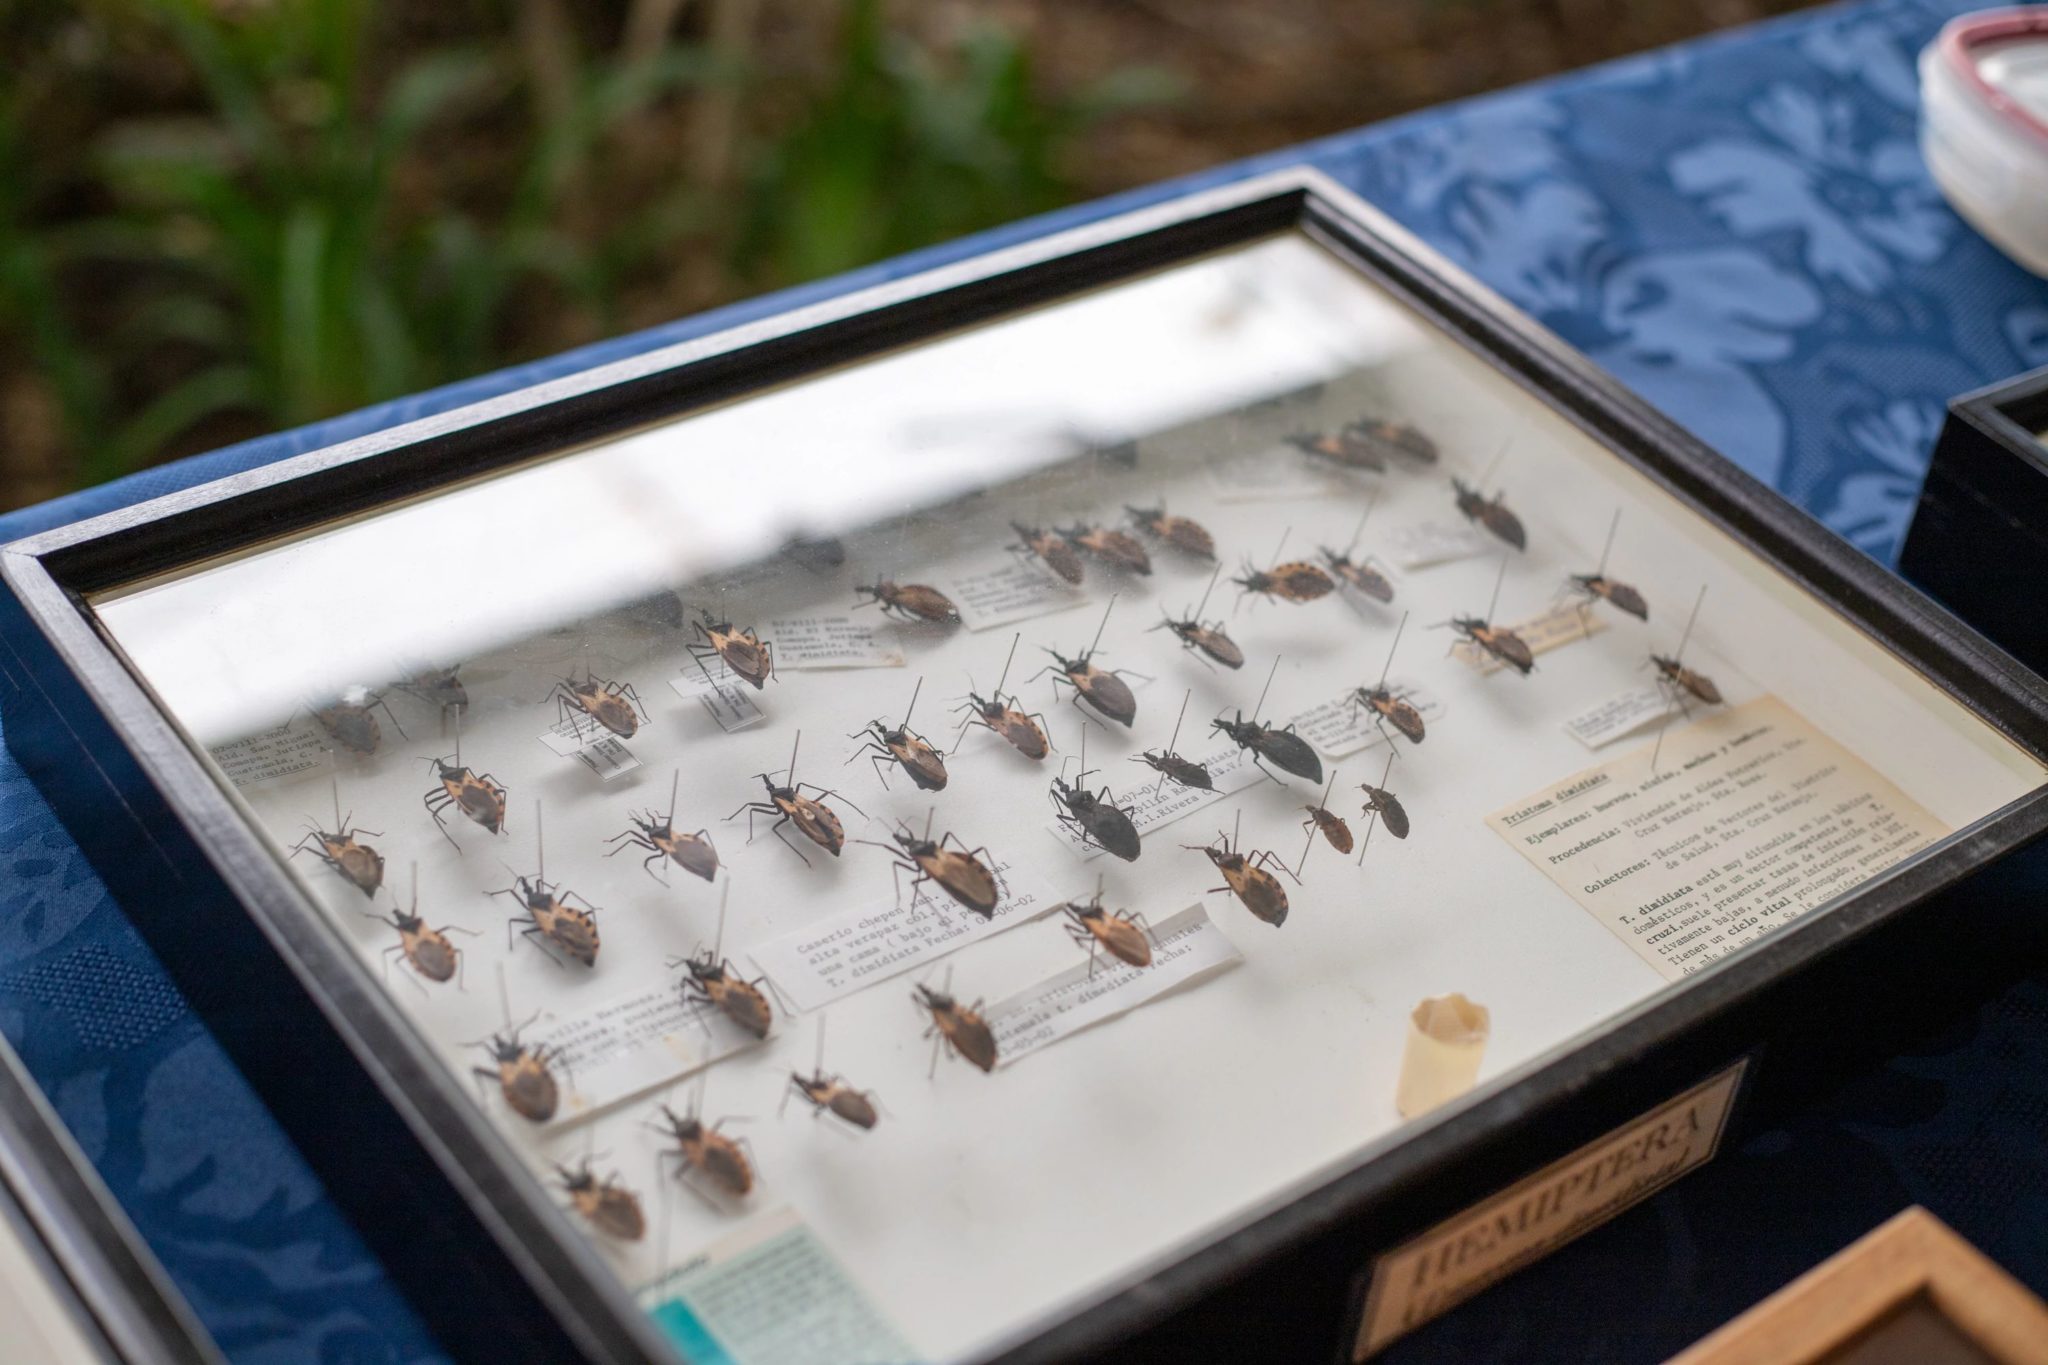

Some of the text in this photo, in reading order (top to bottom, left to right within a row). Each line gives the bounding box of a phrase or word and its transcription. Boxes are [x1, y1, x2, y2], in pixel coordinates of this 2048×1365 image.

[1500, 773, 1610, 827] Triatoma dimidiata
[1525, 811, 1592, 846] Ejemplares:
[1633, 822, 1660, 838] Cruz
[1548, 826, 1621, 864] Procedencia:
[1583, 858, 1651, 895] Colectores:
[1651, 833, 1702, 861] Técnicos
[1703, 823, 1718, 835] de
[1664, 859, 1680, 871] de
[1680, 840, 1719, 862] Salud,
[1719, 828, 1745, 841] Sta.
[1746, 812, 1773, 829] Cruz
[1619, 914, 1636, 926] T.
[1638, 884, 1694, 917] dimidiata
[1695, 868, 1721, 887] está
[1721, 859, 1744, 874] muy
[1744, 830, 1797, 861] difundida
[1633, 900, 1700, 936] domésticos,
[1713, 883, 1728, 894] es
[1728, 874, 1745, 885] un
[1745, 853, 1781, 876] vector
[1713, 878, 1768, 912] presentar
[1769, 861, 1800, 880] tasas
[1801, 852, 1816, 863] de
[796, 926, 853, 954] Caserio
[808, 947, 841, 966] alta
[845, 923, 900, 949] verapaz
[826, 976, 846, 988] T.
[851, 945, 921, 979] dimidiata
[923, 924, 971, 949] Fecha:
[974, 892, 1036, 927] 0-06-02
[1656, 924, 1713, 956] tivamente
[1713, 905, 1752, 927] bajas,
[1764, 874, 1802, 899] menudo
[1667, 942, 1710, 967] Tienen
[1710, 934, 1727, 945] un
[1727, 914, 1759, 937] ciclo
[1759, 896, 1792, 918] vital
[1793, 865, 1856, 901] prolongado,
[1682, 964, 1697, 978] de
[1721, 943, 1736, 955] de
[1782, 910, 1798, 922] Se
[1802, 899, 1816, 911] le
[818, 960, 844, 977] una
[848, 944, 881, 964] cama
[898, 924, 933, 943] bajo
[1414, 1106, 1699, 1288] HEMIPTERA
